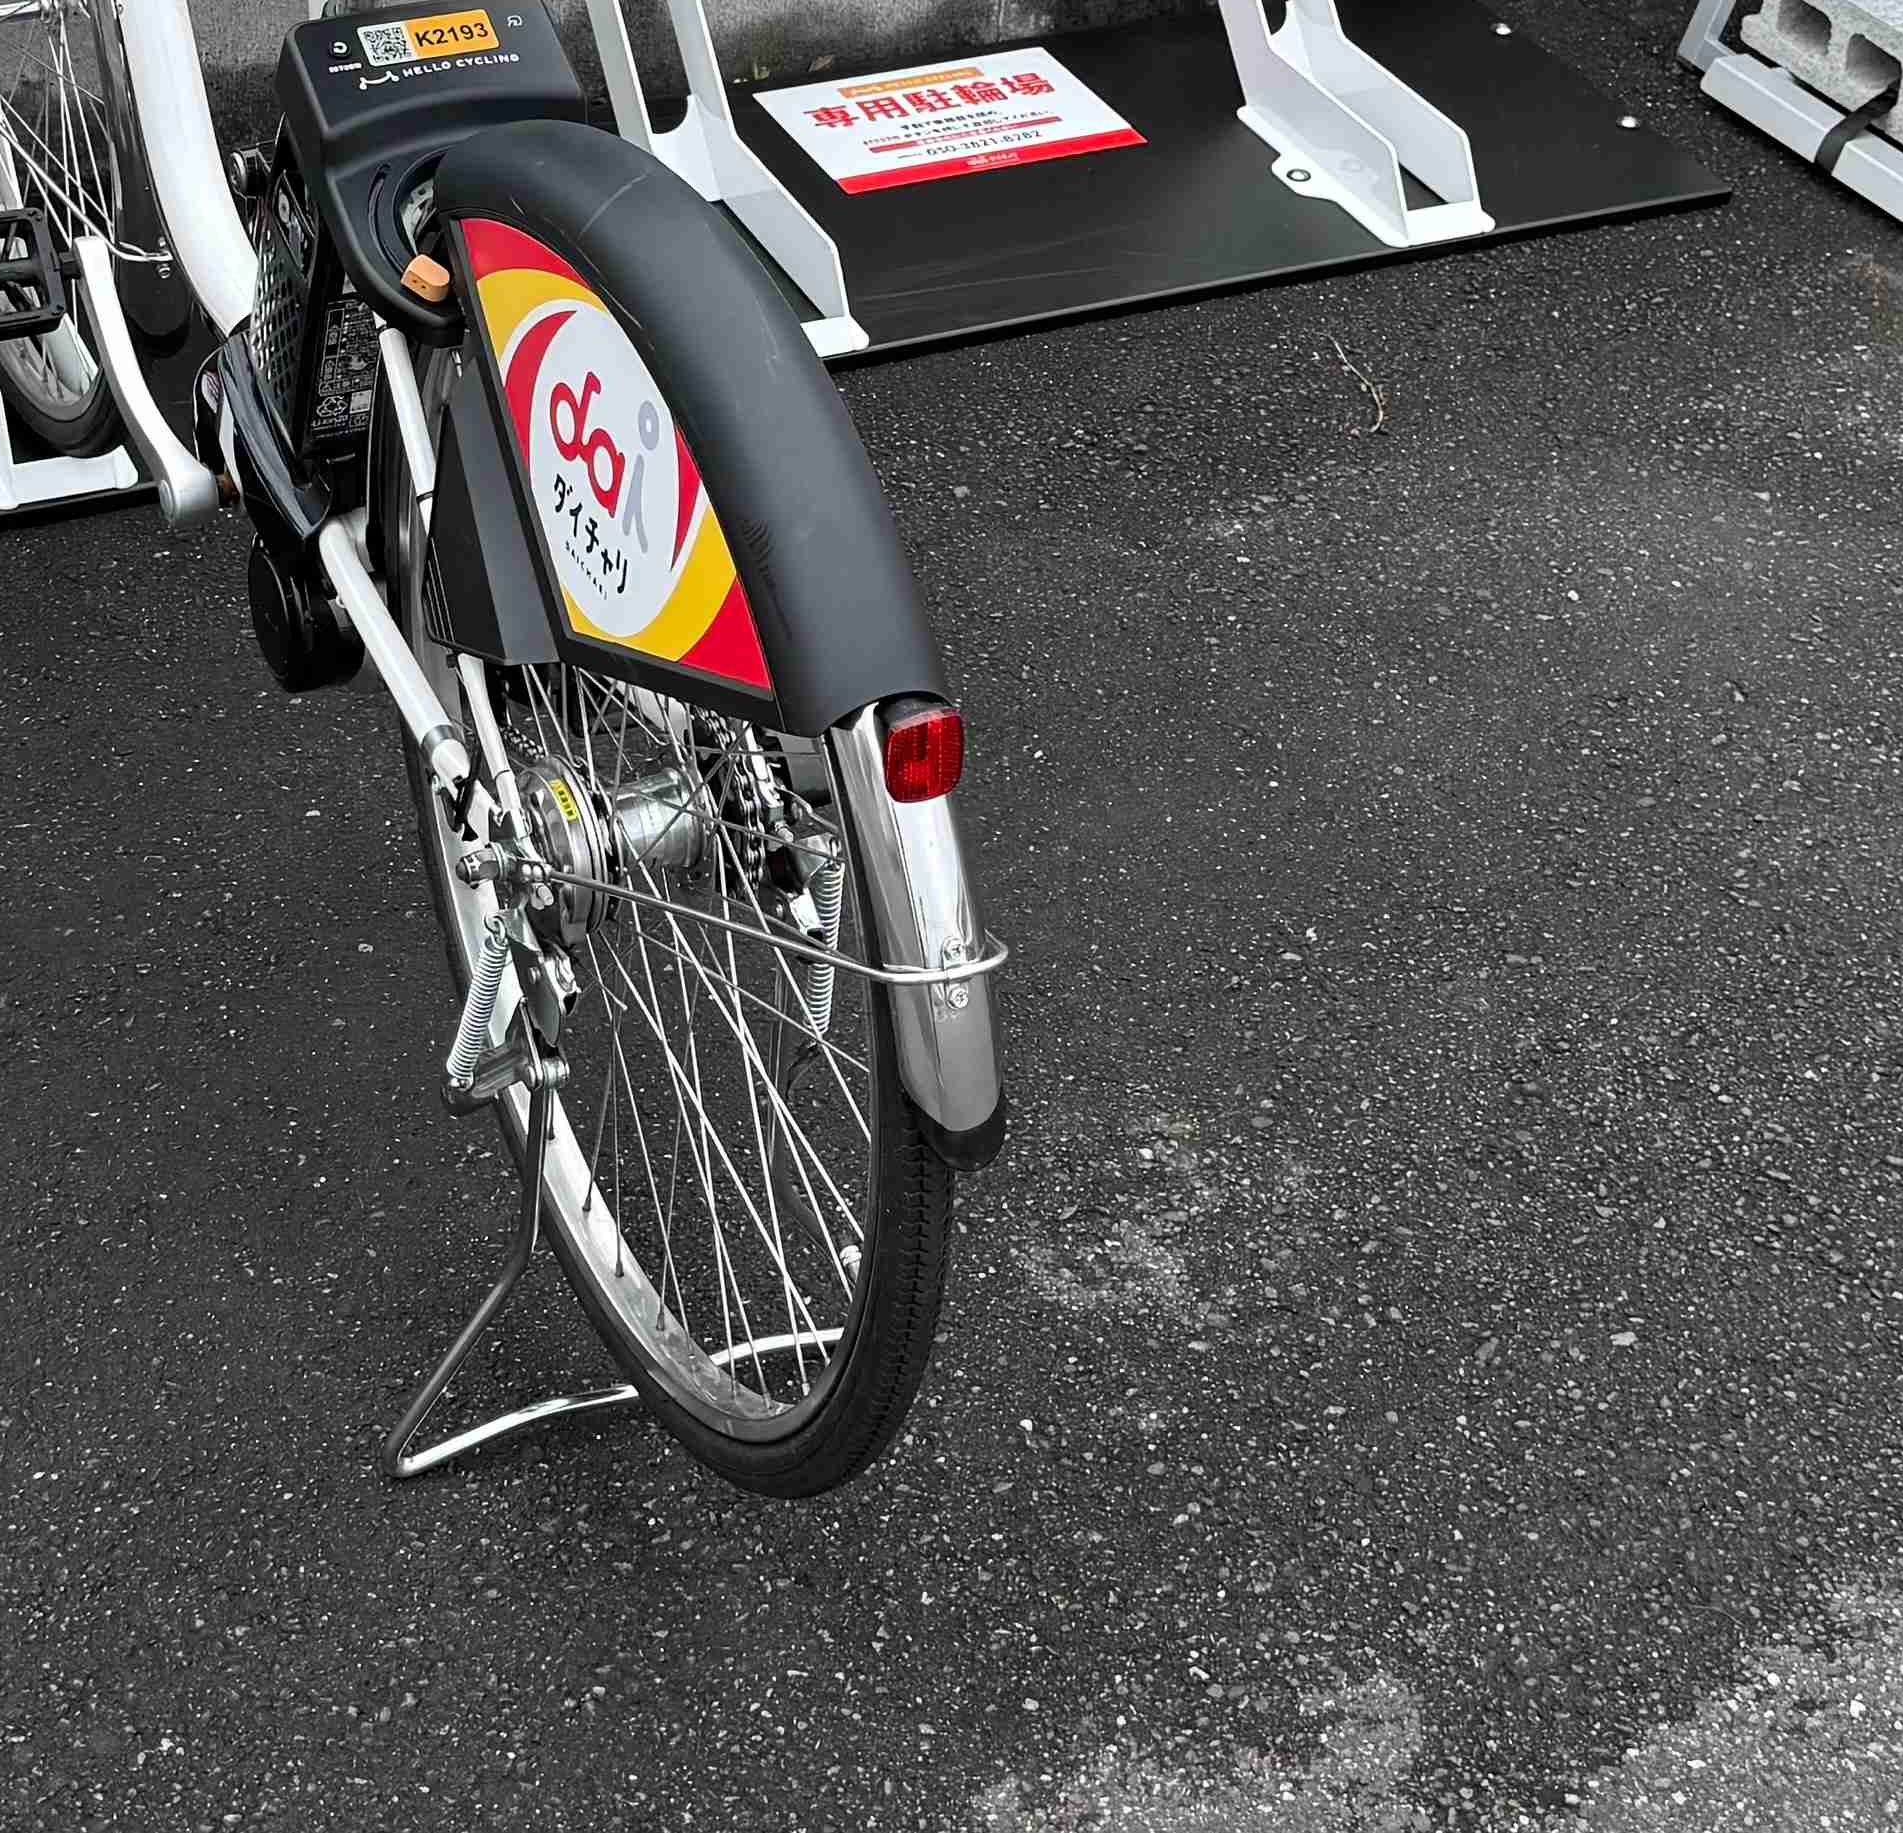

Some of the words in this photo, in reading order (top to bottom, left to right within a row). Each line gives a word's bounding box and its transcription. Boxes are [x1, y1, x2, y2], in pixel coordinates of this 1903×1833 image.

[414, 22, 489, 48] K2193
[402, 60, 451, 78] HELLO
[455, 53, 520, 69] CYCLING
[803, 72, 1056, 128] 専用駐輪場
[553, 472, 629, 595] ダイチャリ
